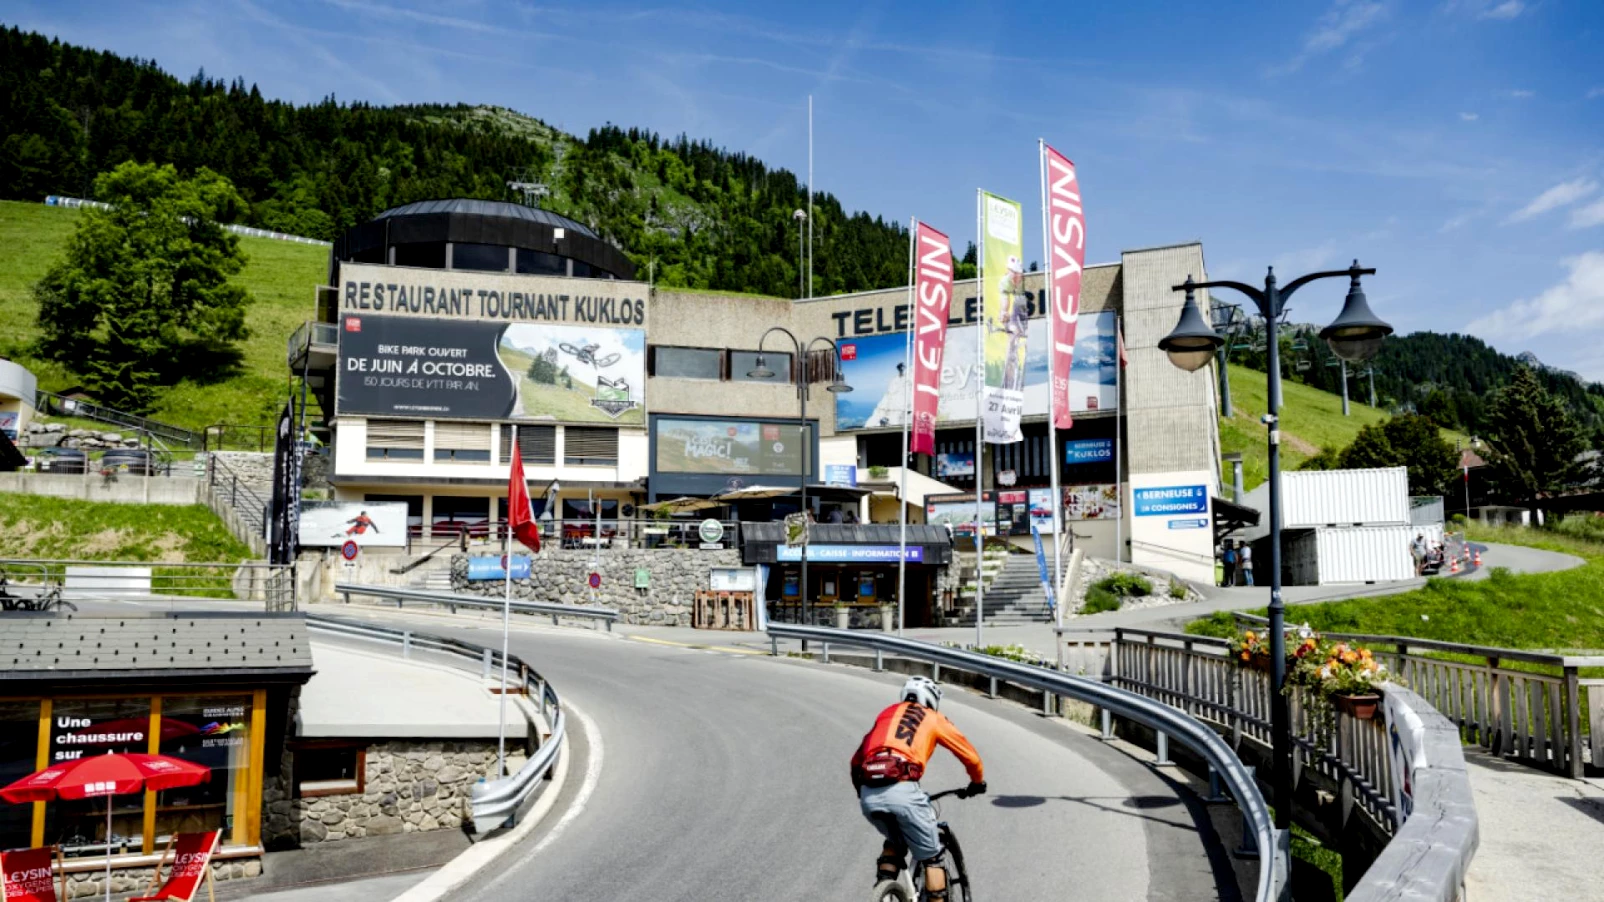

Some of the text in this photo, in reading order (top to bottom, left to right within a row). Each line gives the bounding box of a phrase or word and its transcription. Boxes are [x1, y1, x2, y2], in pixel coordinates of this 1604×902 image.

[345, 281, 645, 325] RESTAURANT TOURNANT KUKLOS
[831, 303, 915, 337] TELE
[378, 344, 468, 359] BIKE PARK OUVERT
[348, 357, 368, 371] DE
[370, 359, 403, 374] JUIN
[422, 361, 496, 378] OCTOBRE.
[378, 376, 410, 389] JOURS
[411, 379, 424, 389] DE
[426, 379, 445, 390] VTT
[446, 380, 464, 391] PAR
[988, 401, 1023, 415] 27 Avril
[1074, 449, 1111, 459] KUKLOS
[1142, 488, 1194, 500] BERNEUSE
[1151, 503, 1198, 512] CONSIGNES
[820, 549, 847, 558] CAISSE
[57, 716, 92, 729] Une
[55, 730, 144, 745] chaussure
[55, 749, 84, 760] sur
[4, 866, 52, 884] LEYSIN
